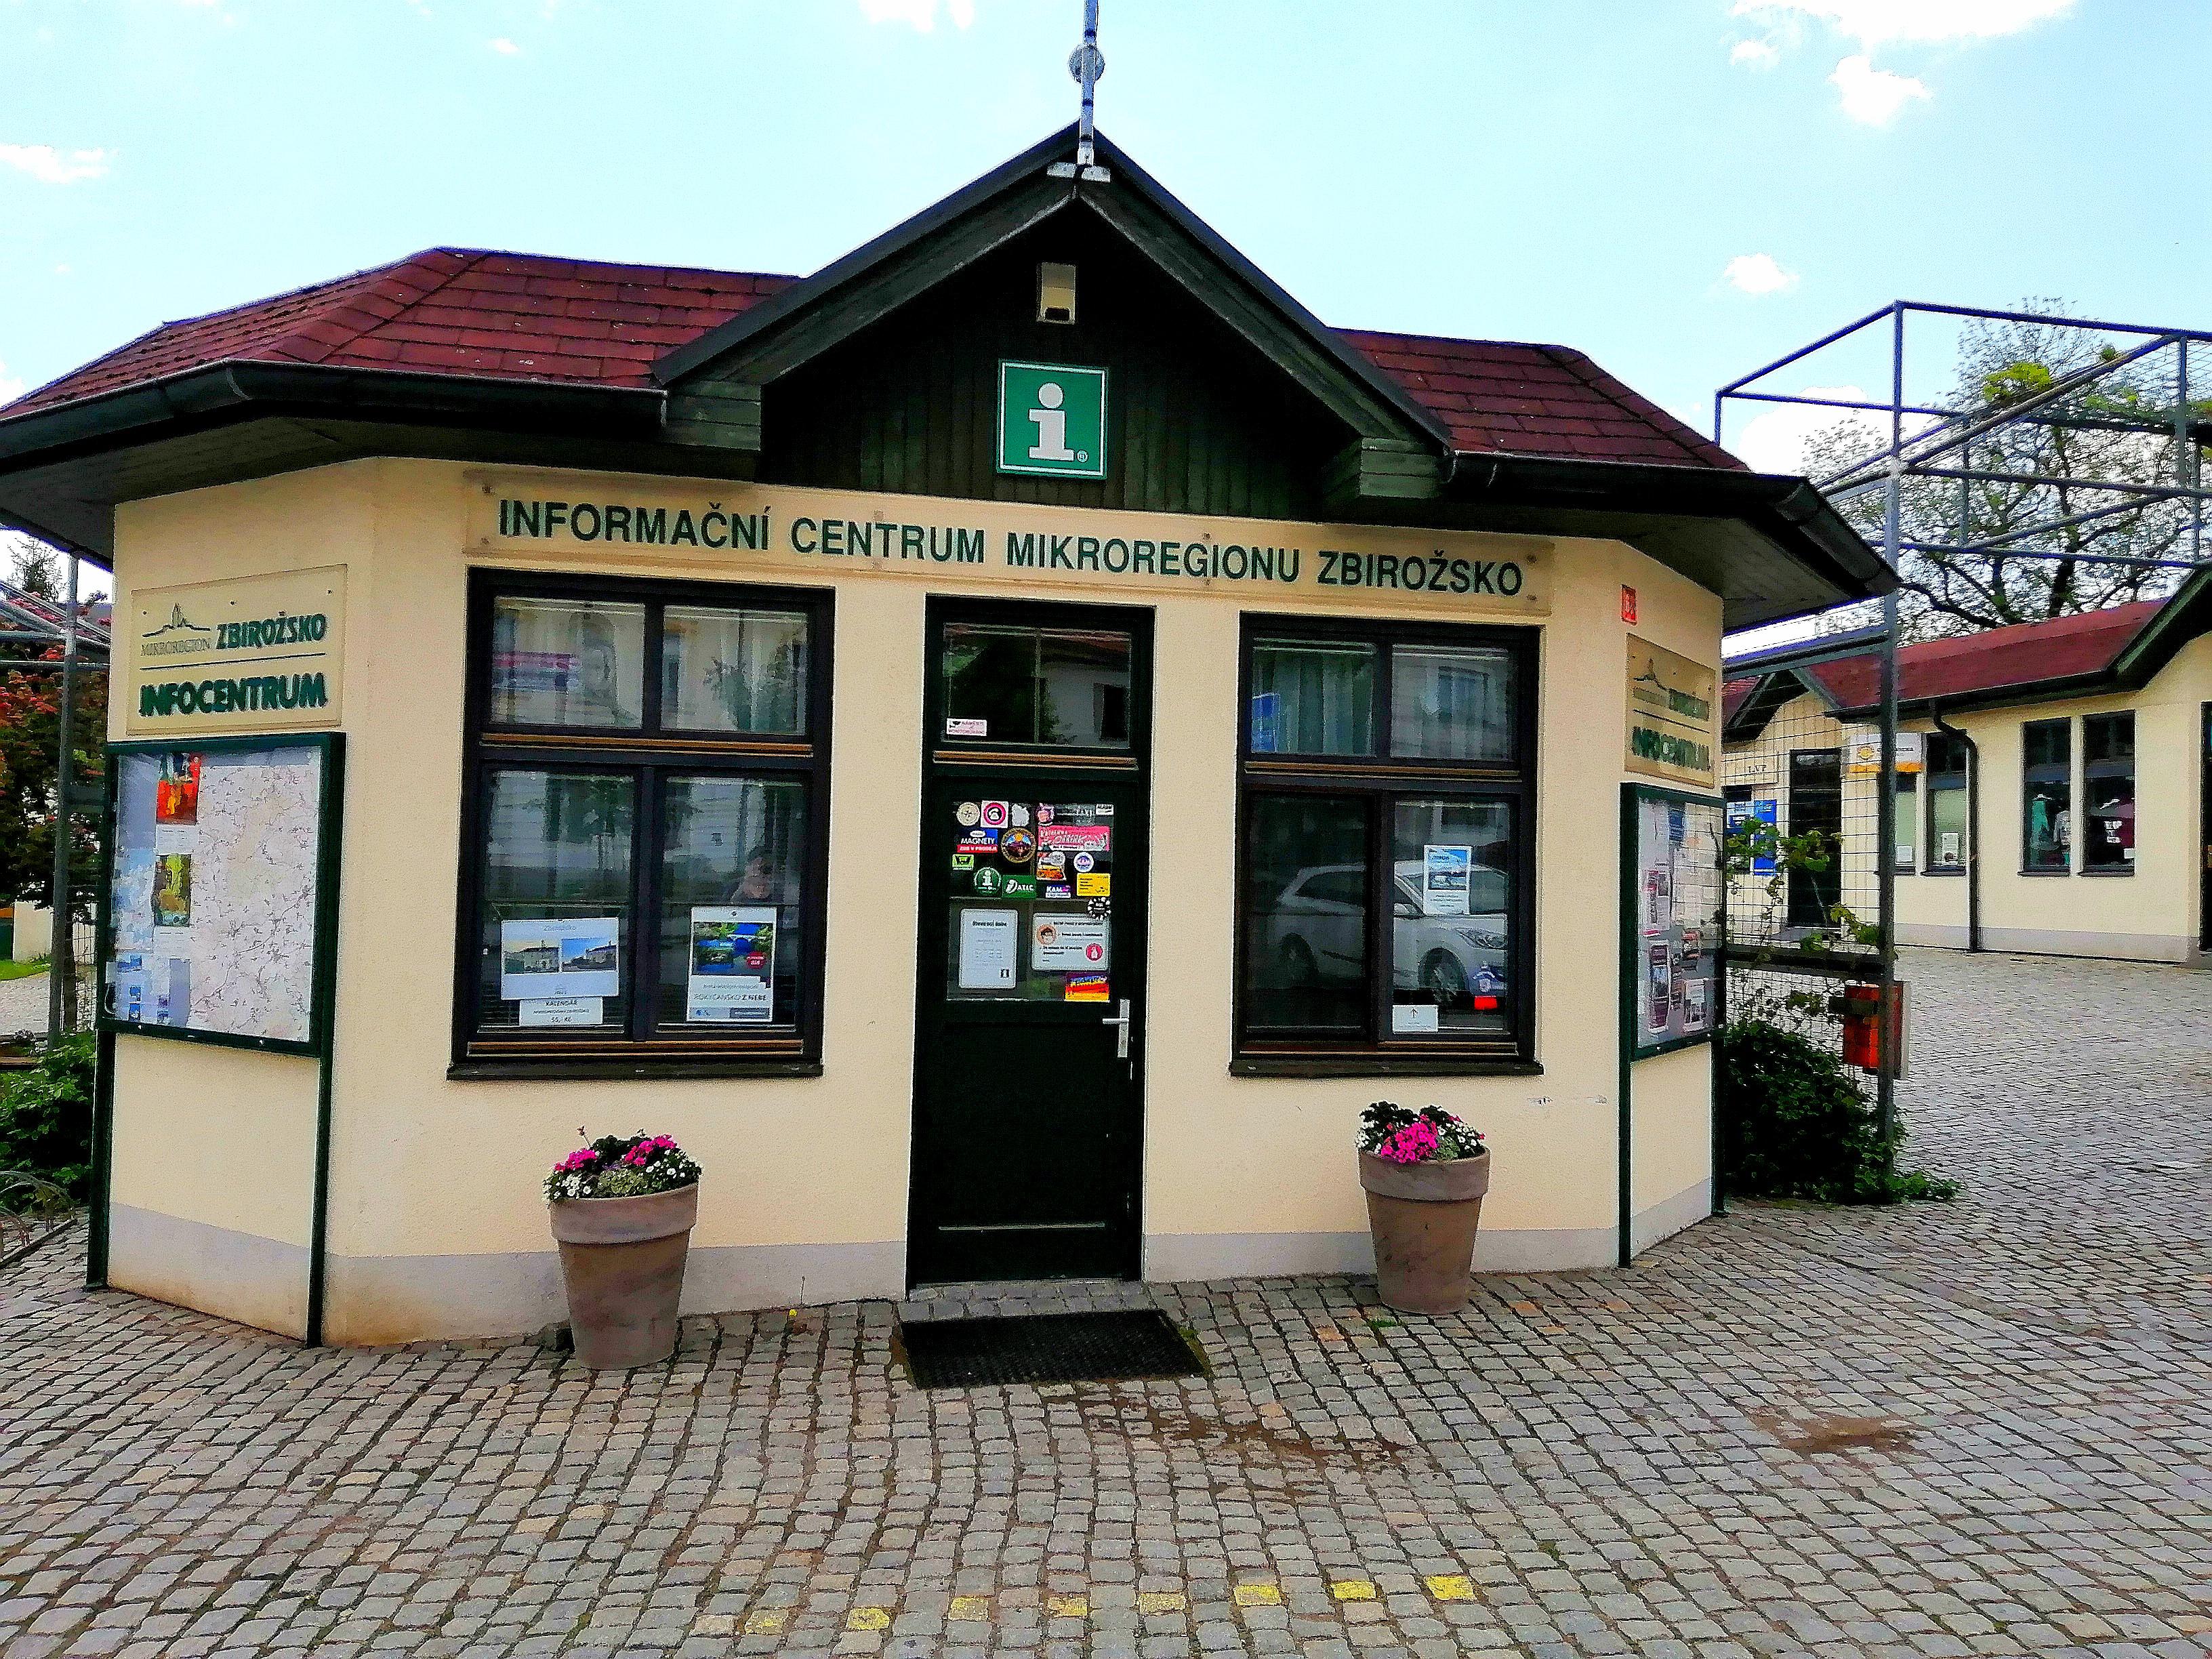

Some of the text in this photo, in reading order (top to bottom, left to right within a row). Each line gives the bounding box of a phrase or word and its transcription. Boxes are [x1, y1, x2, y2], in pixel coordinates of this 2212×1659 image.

[499, 499, 1523, 596] INFORMAČNÍ CENTRUM MIKROREGIONU ZBIROŽSKO
[216, 611, 327, 649] ZBIROŽSKO
[138, 672, 327, 716] INFOCENTRUM
